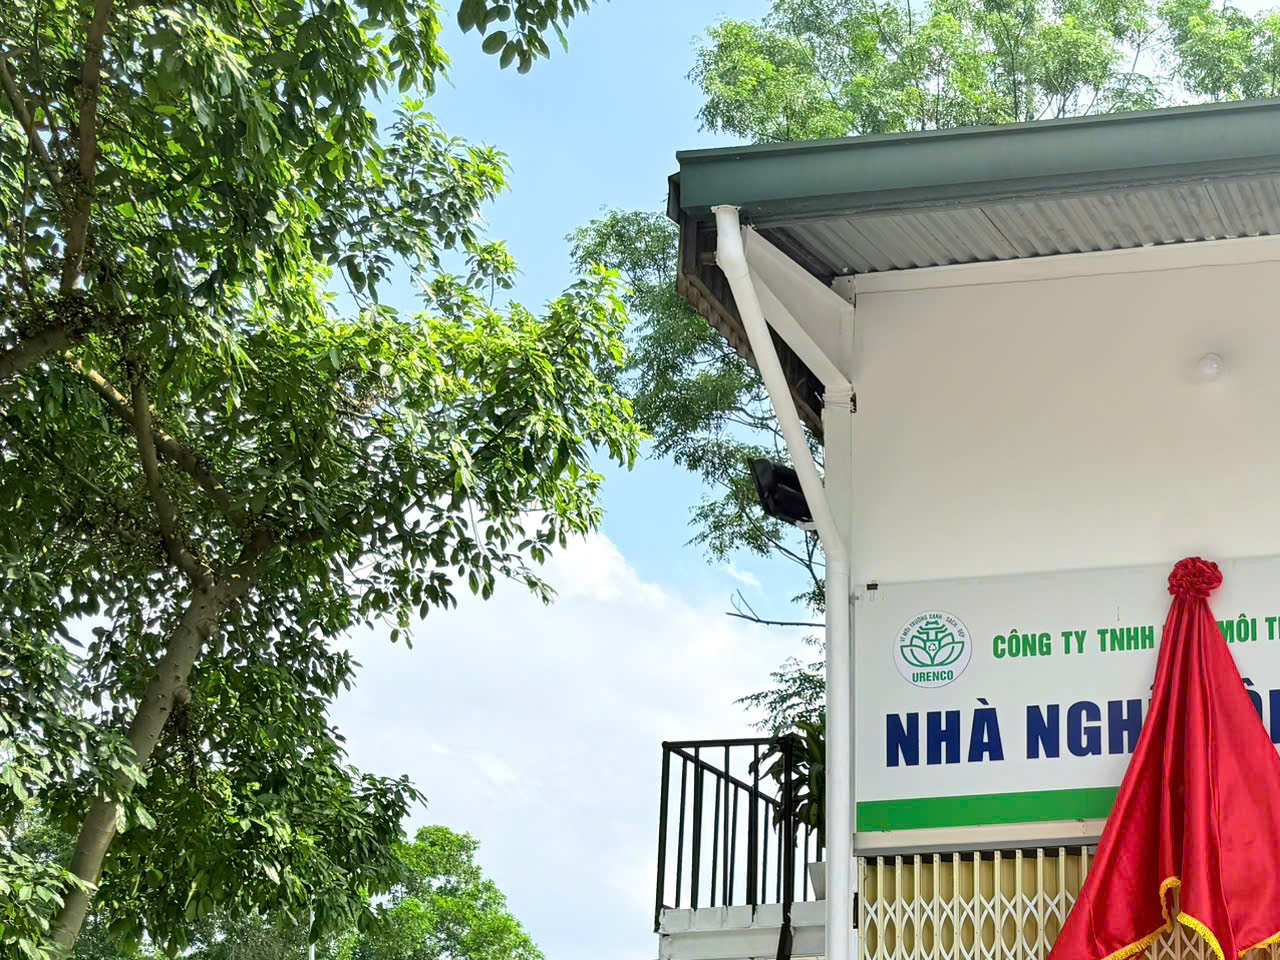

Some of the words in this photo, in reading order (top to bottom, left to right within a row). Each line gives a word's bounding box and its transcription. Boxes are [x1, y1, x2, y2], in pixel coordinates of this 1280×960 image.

[993, 629, 1052, 659] CÔNG
[1061, 630, 1087, 655] TY
[1097, 626, 1155, 653] TNHH
[1216, 613, 1257, 643] MÔI
[912, 670, 954, 683] URENCO
[886, 698, 1005, 768] NHÀ
[1026, 696, 1152, 760] NGH
